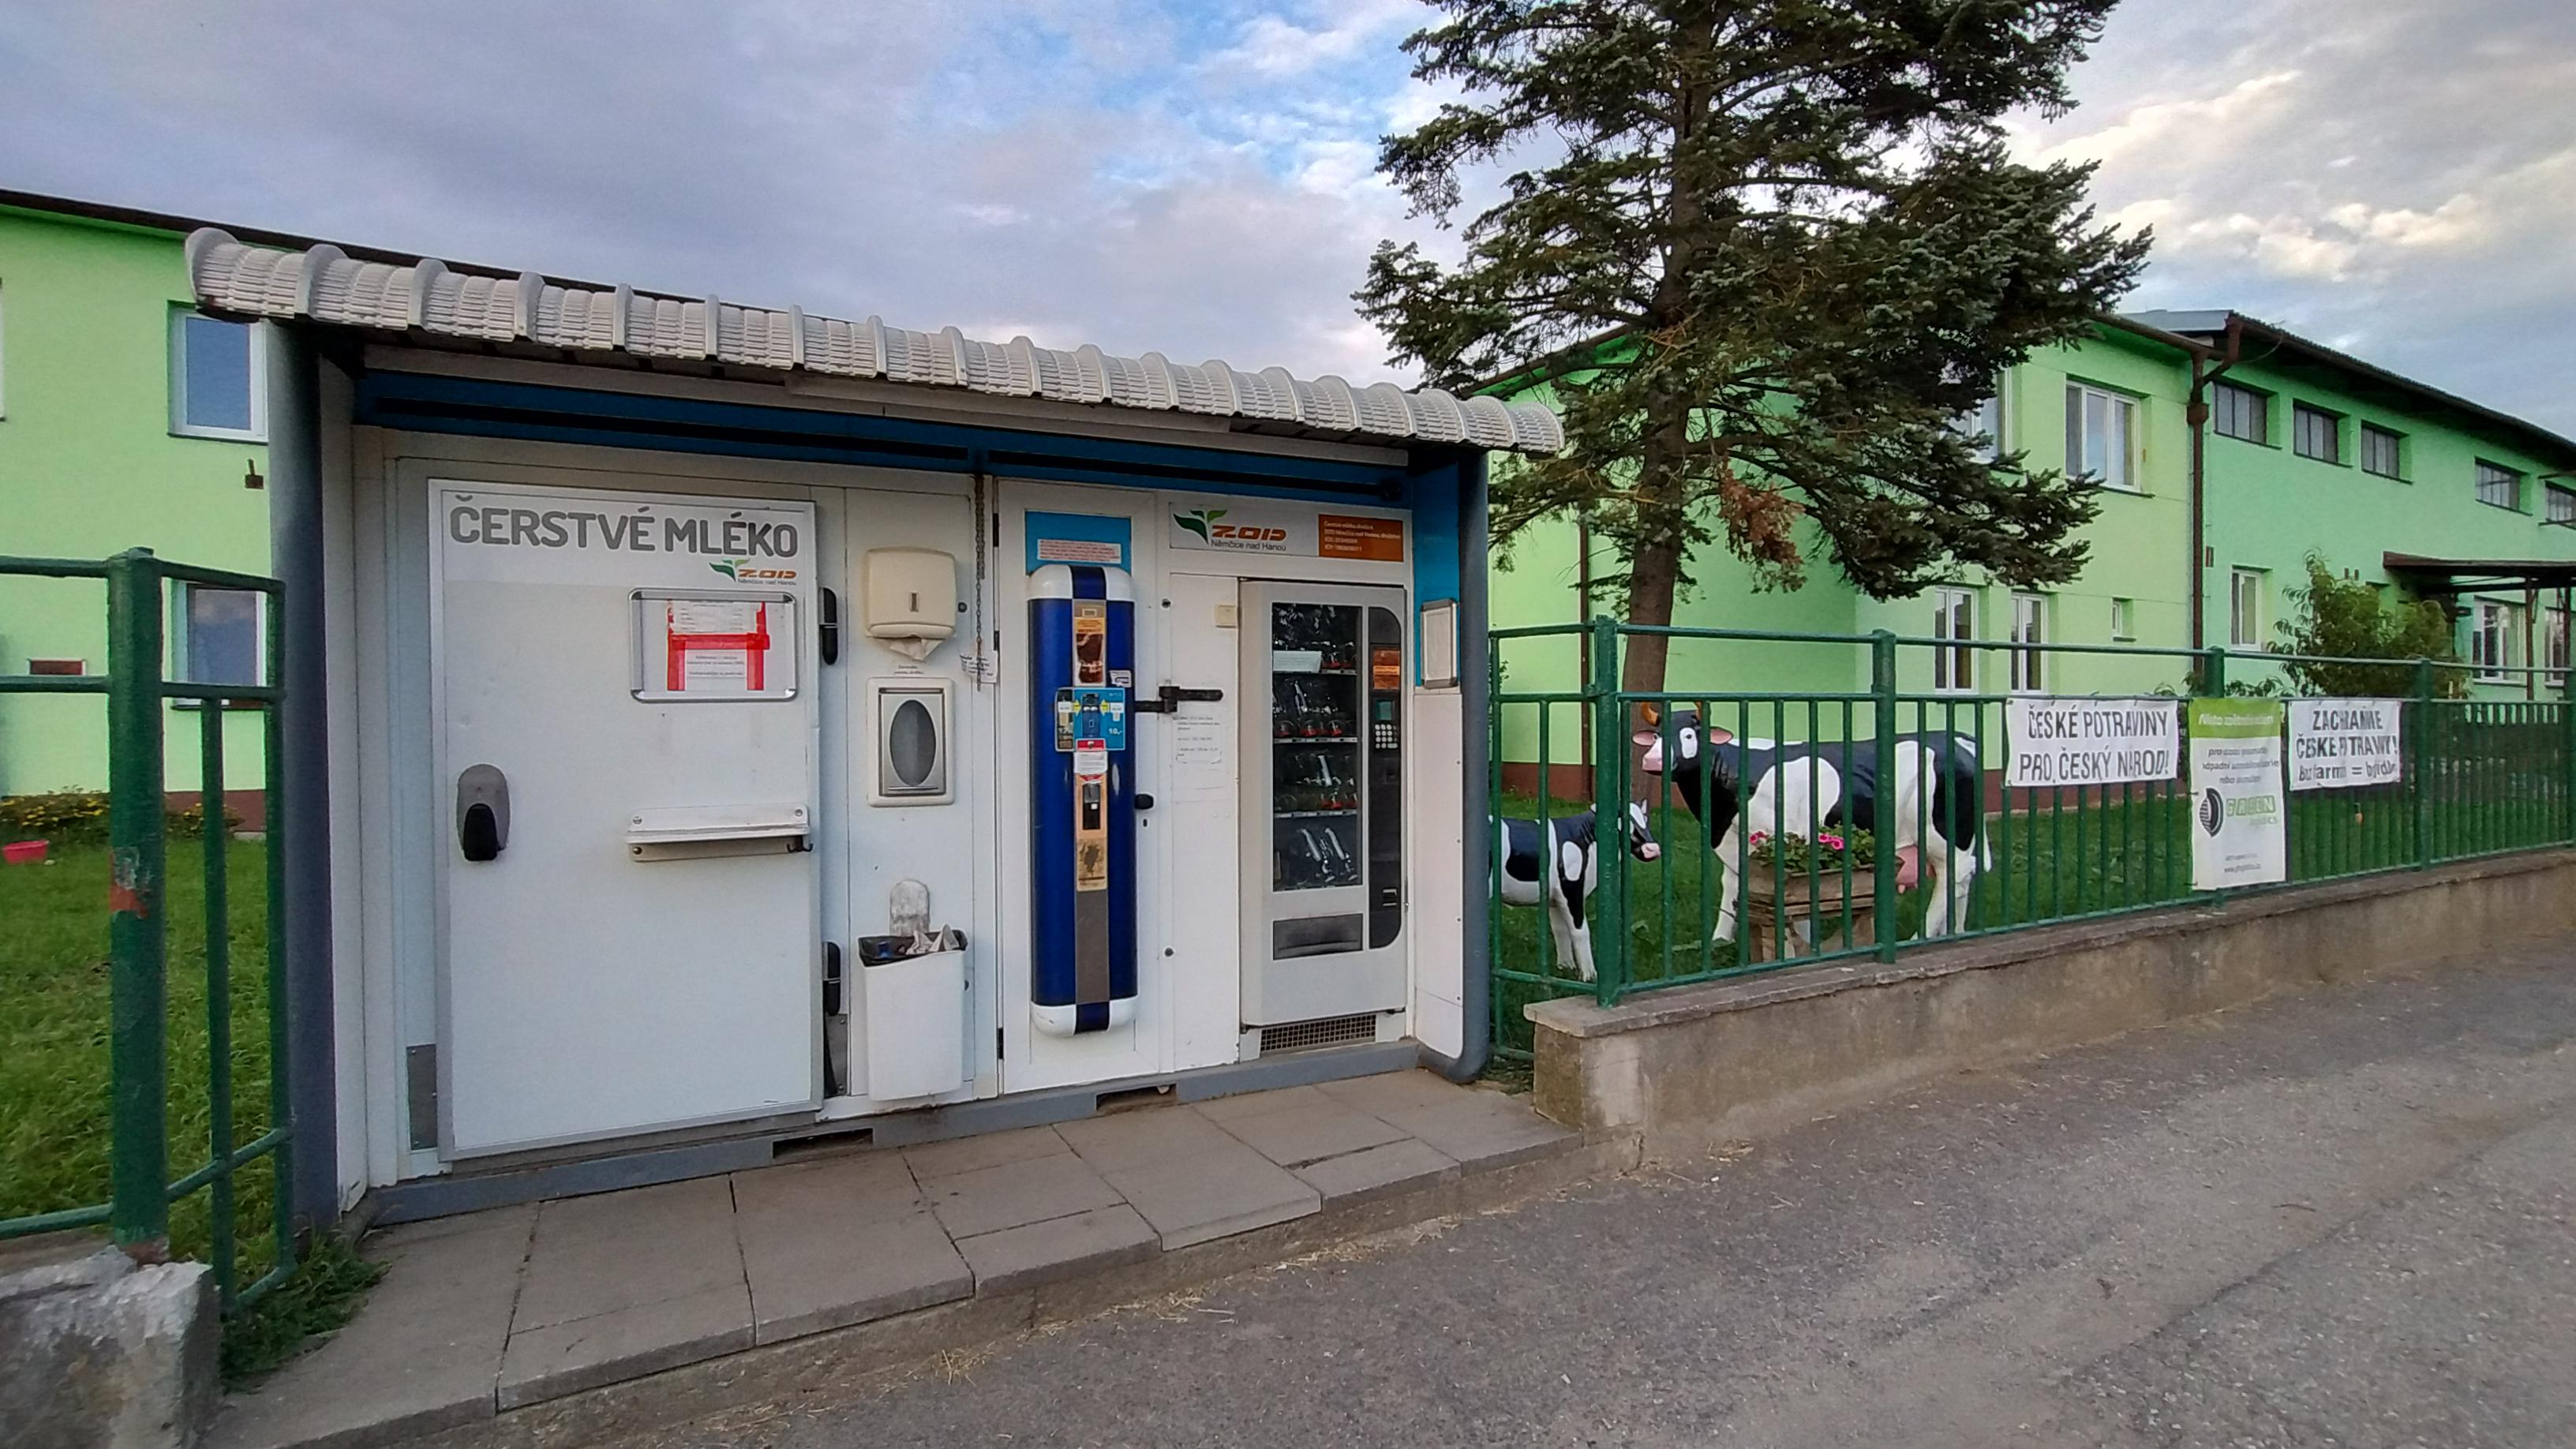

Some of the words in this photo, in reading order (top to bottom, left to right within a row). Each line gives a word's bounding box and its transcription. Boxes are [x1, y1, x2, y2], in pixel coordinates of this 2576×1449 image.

[450, 494, 656, 552] ČERSTVÉ
[665, 511, 799, 558] MLÉKO
[1211, 524, 1287, 541] ZOD
[1211, 539, 1245, 549] Němčice
[1246, 541, 1260, 550] nad
[1263, 542, 1287, 552] Hanou
[739, 569, 797, 579] ZOD
[2028, 704, 2079, 739] ČESKÉ
[2083, 710, 2168, 739] POTRAVINY
[2019, 753, 2052, 781] PRO
[2059, 745, 2112, 781] ČESKÝ
[2117, 749, 2170, 777] NROD!
